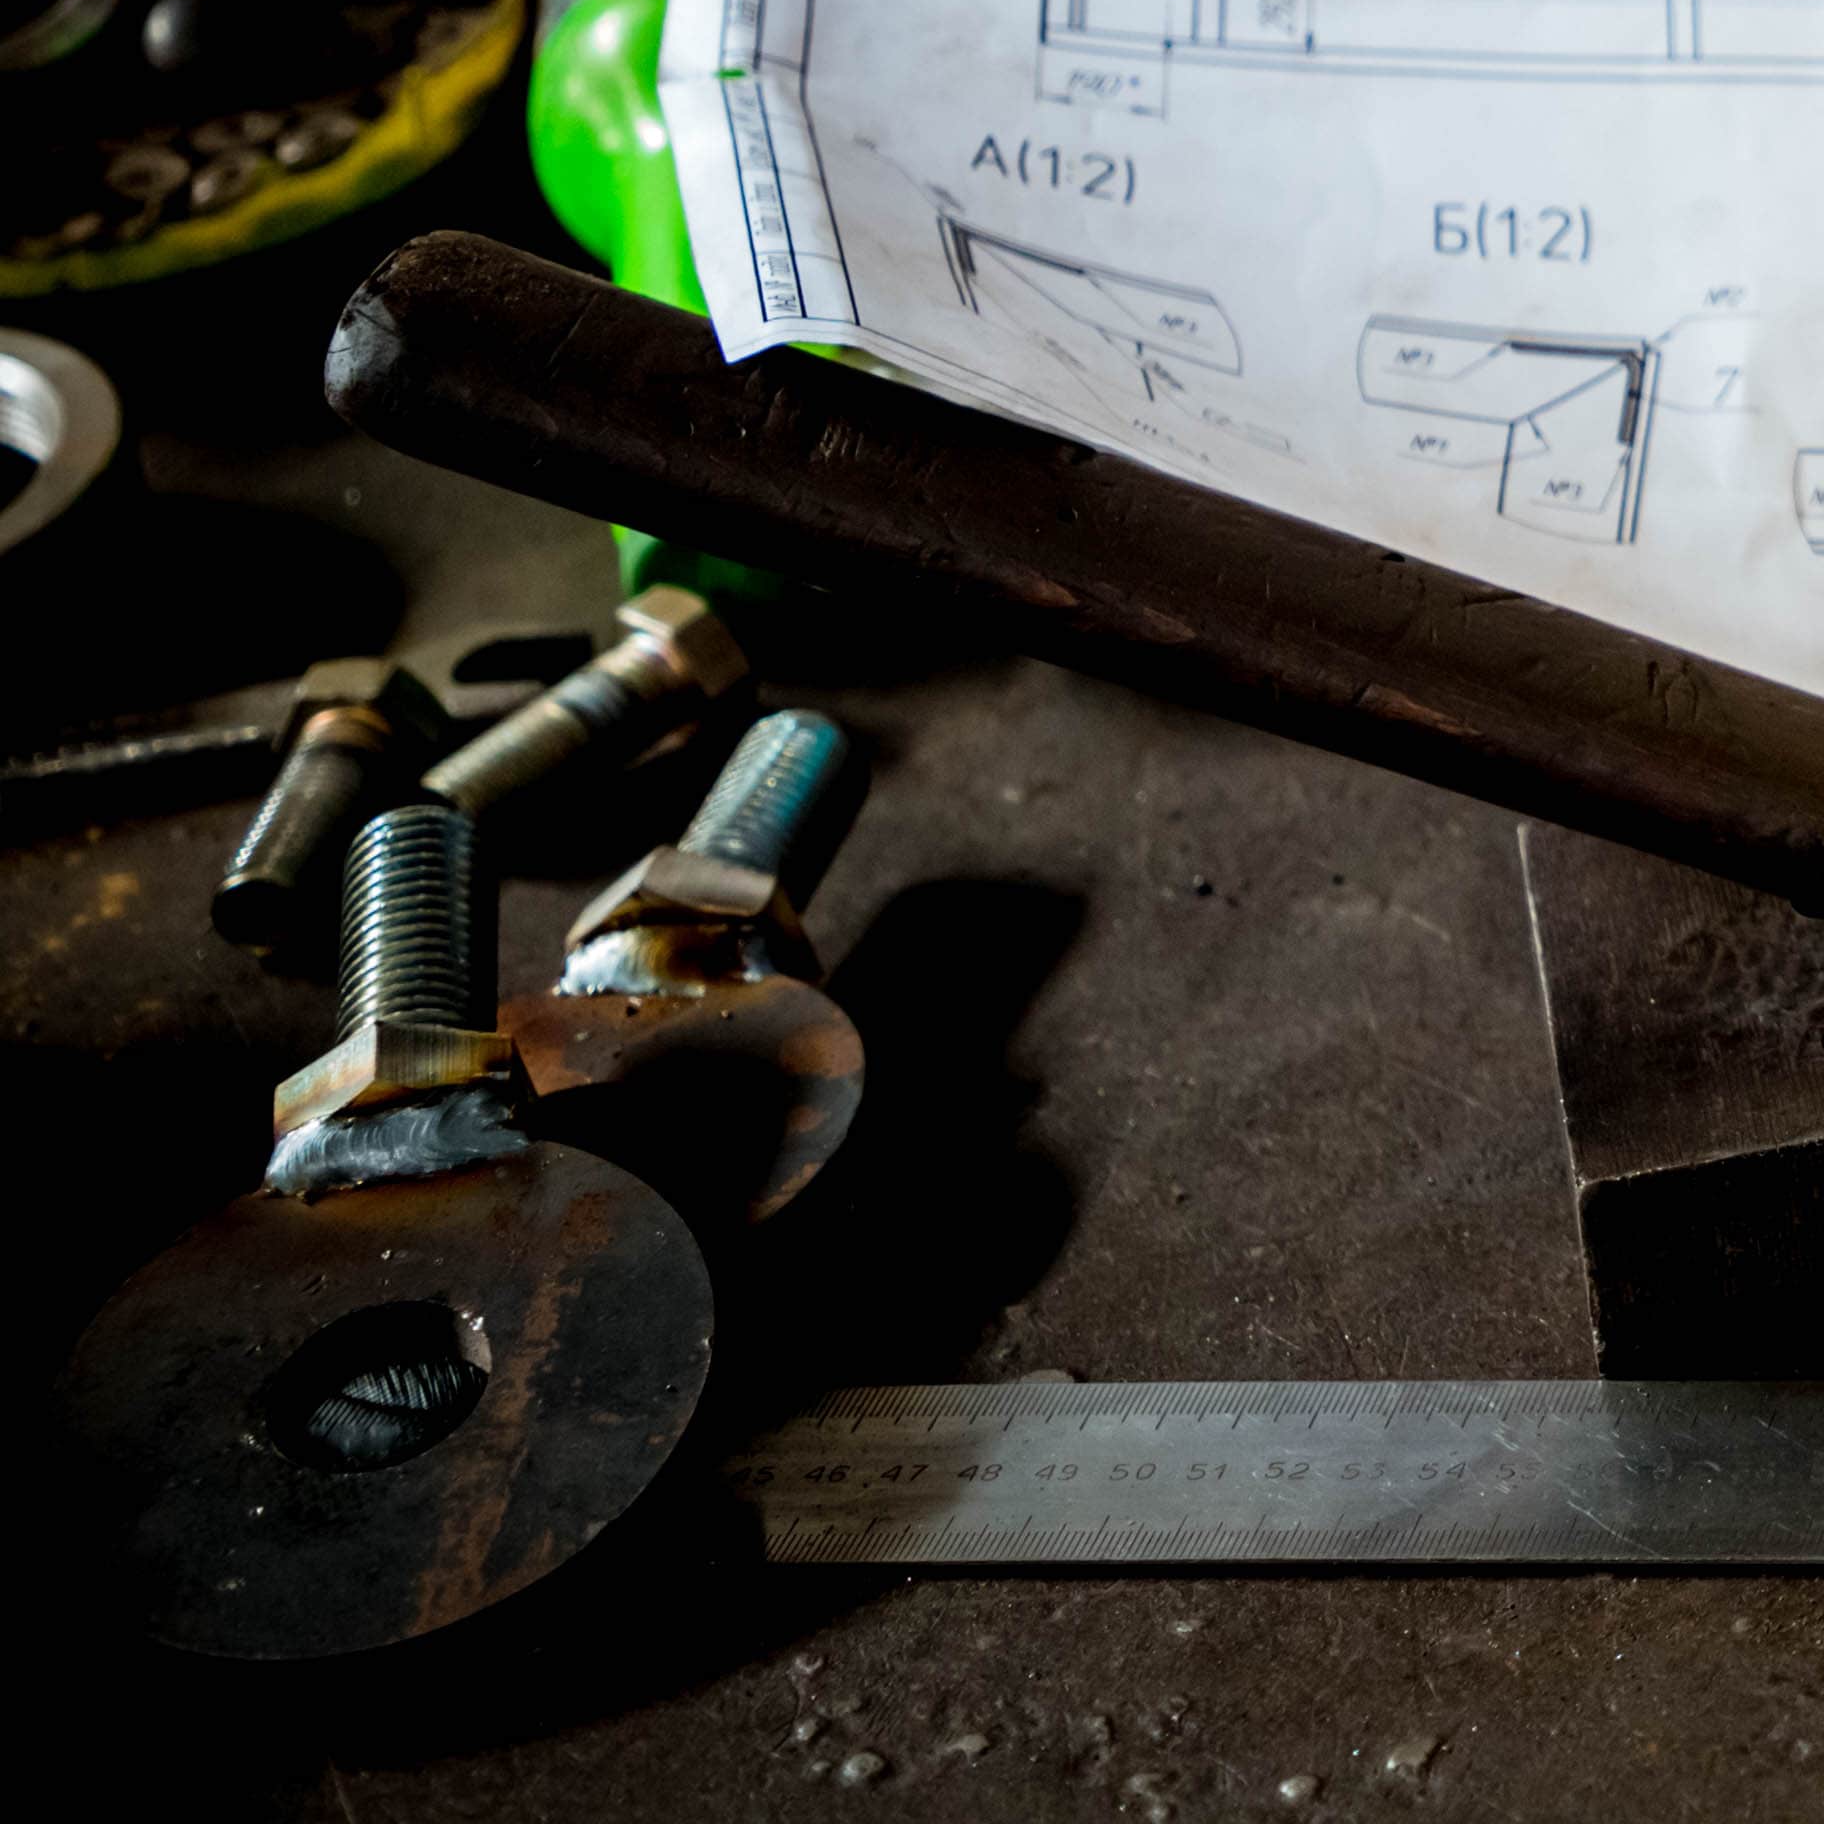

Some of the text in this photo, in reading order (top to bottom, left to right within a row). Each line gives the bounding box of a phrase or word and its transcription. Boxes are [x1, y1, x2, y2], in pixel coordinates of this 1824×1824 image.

[802, 1464, 851, 1483] 46
[880, 1463, 930, 1483] 47
[959, 1463, 1004, 1482] 48
[1035, 1463, 1081, 1482] 49
[1109, 1463, 1157, 1482] 50
[1186, 1462, 1228, 1481] 51
[1264, 1462, 1312, 1481] 52
[1418, 1461, 1469, 1481] 54
